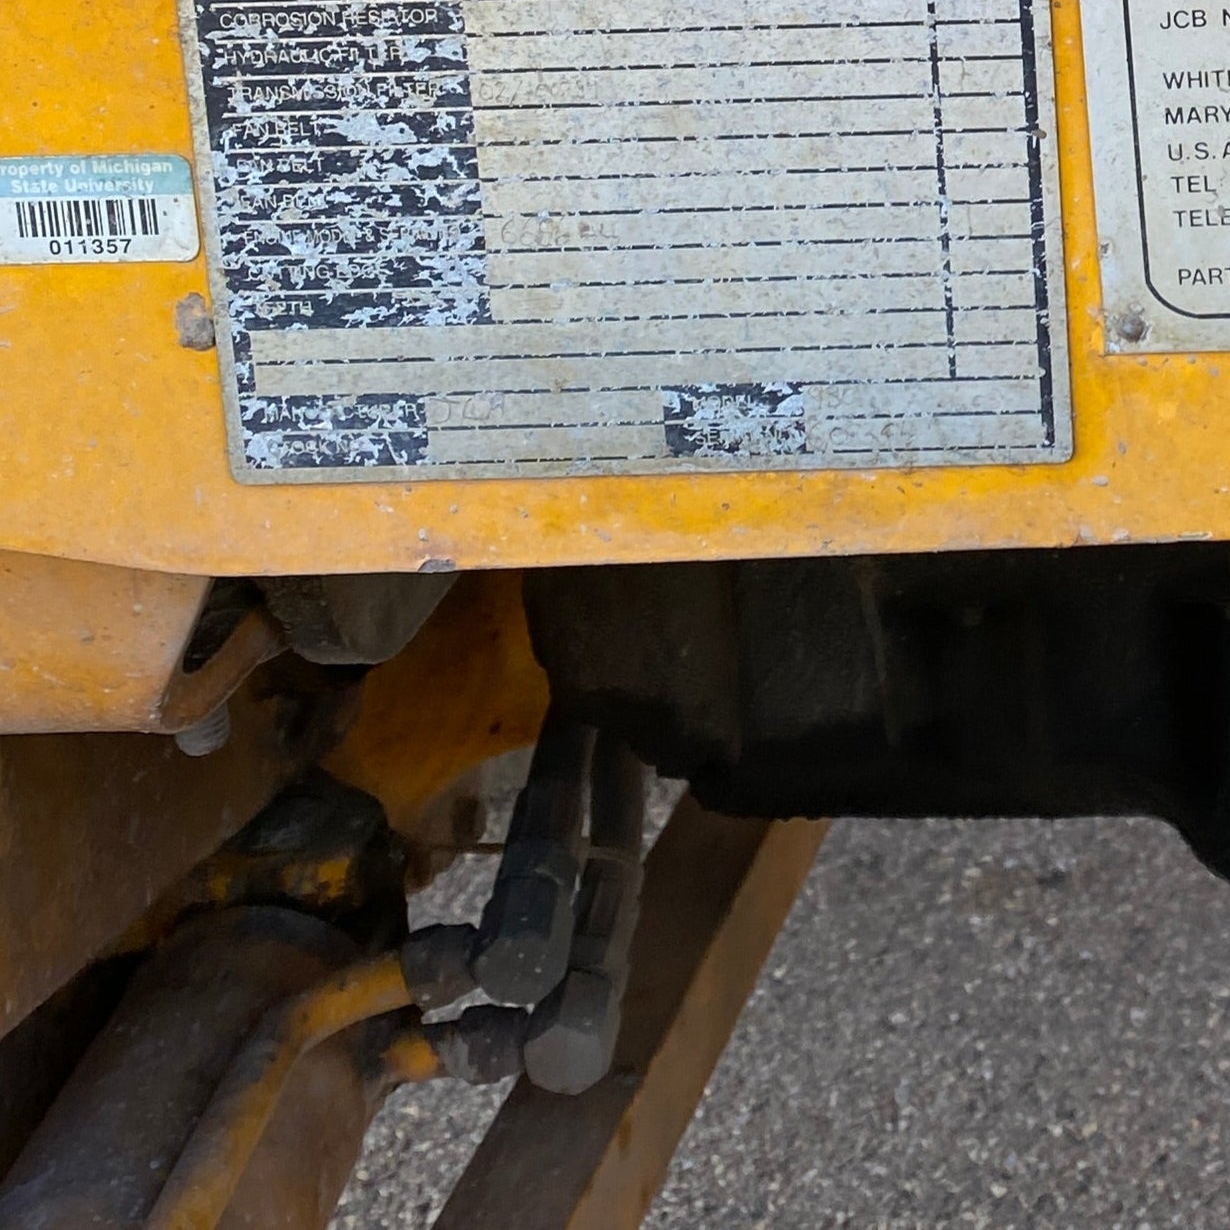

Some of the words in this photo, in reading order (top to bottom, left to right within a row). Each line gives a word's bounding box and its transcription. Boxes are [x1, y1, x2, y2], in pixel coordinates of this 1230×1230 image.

[219, 11, 337, 29] CORROSION
[1160, 9, 1207, 30] JCB
[0, 161, 63, 177] roperty
[70, 160, 86, 175] of
[92, 159, 173, 176] Michigan
[11, 180, 58, 194] State
[64, 178, 155, 194] University
[50, 238, 132, 255] 011357
